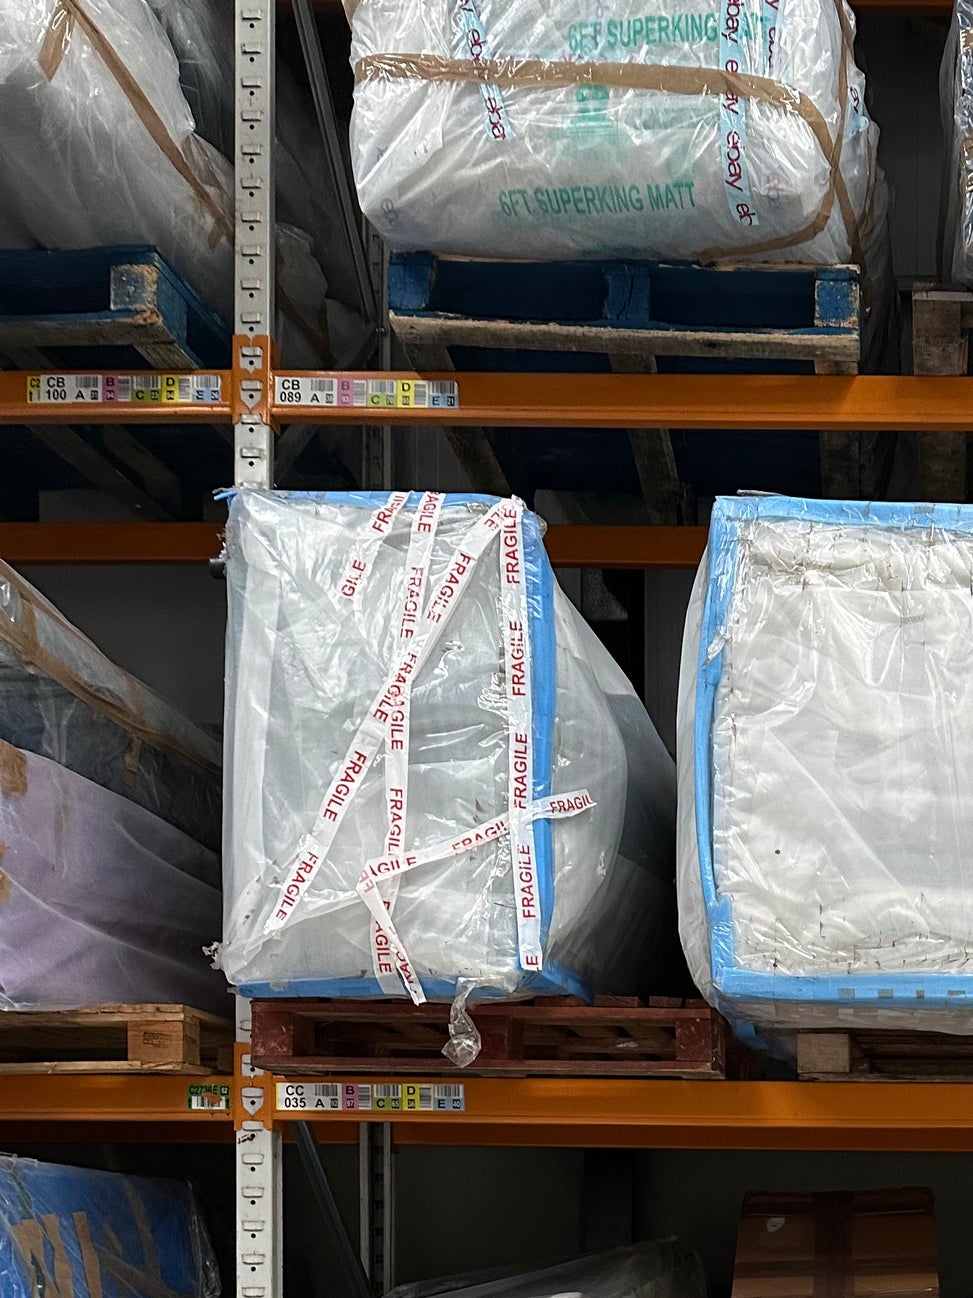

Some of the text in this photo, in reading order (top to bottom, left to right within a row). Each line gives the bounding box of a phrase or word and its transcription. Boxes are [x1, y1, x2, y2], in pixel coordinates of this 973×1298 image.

[607, 12, 718, 48] SUPERKING
[725, 130, 744, 192] ebay
[500, 181, 696, 217] 6FT SUPERKING MATT
[46, 376, 175, 389] CB B D
[46, 389, 67, 401] 100
[75, 390, 86, 400] A
[135, 390, 145, 400] C
[279, 391, 302, 403] 089
[310, 393, 320, 403] A
[370, 395, 380, 405] C
[432, 396, 441, 406] E
[281, 379, 411, 392] CB B D
[504, 508, 521, 585] FRAGILE
[508, 620, 525, 696] FRAGILE
[373, 652, 418, 723] FRAGILE
[322, 750, 368, 823] FRAGILE
[513, 732, 528, 809] FRAGILE
[275, 850, 318, 921] FRAGILE
[521, 844, 536, 918] FRAGILE
[284, 1097, 306, 1108] 035
[315, 1099, 324, 1108] A
[376, 1099, 385, 1108] C
[438, 1099, 446, 1108] E
[286, 1085, 415, 1096] CC B D
